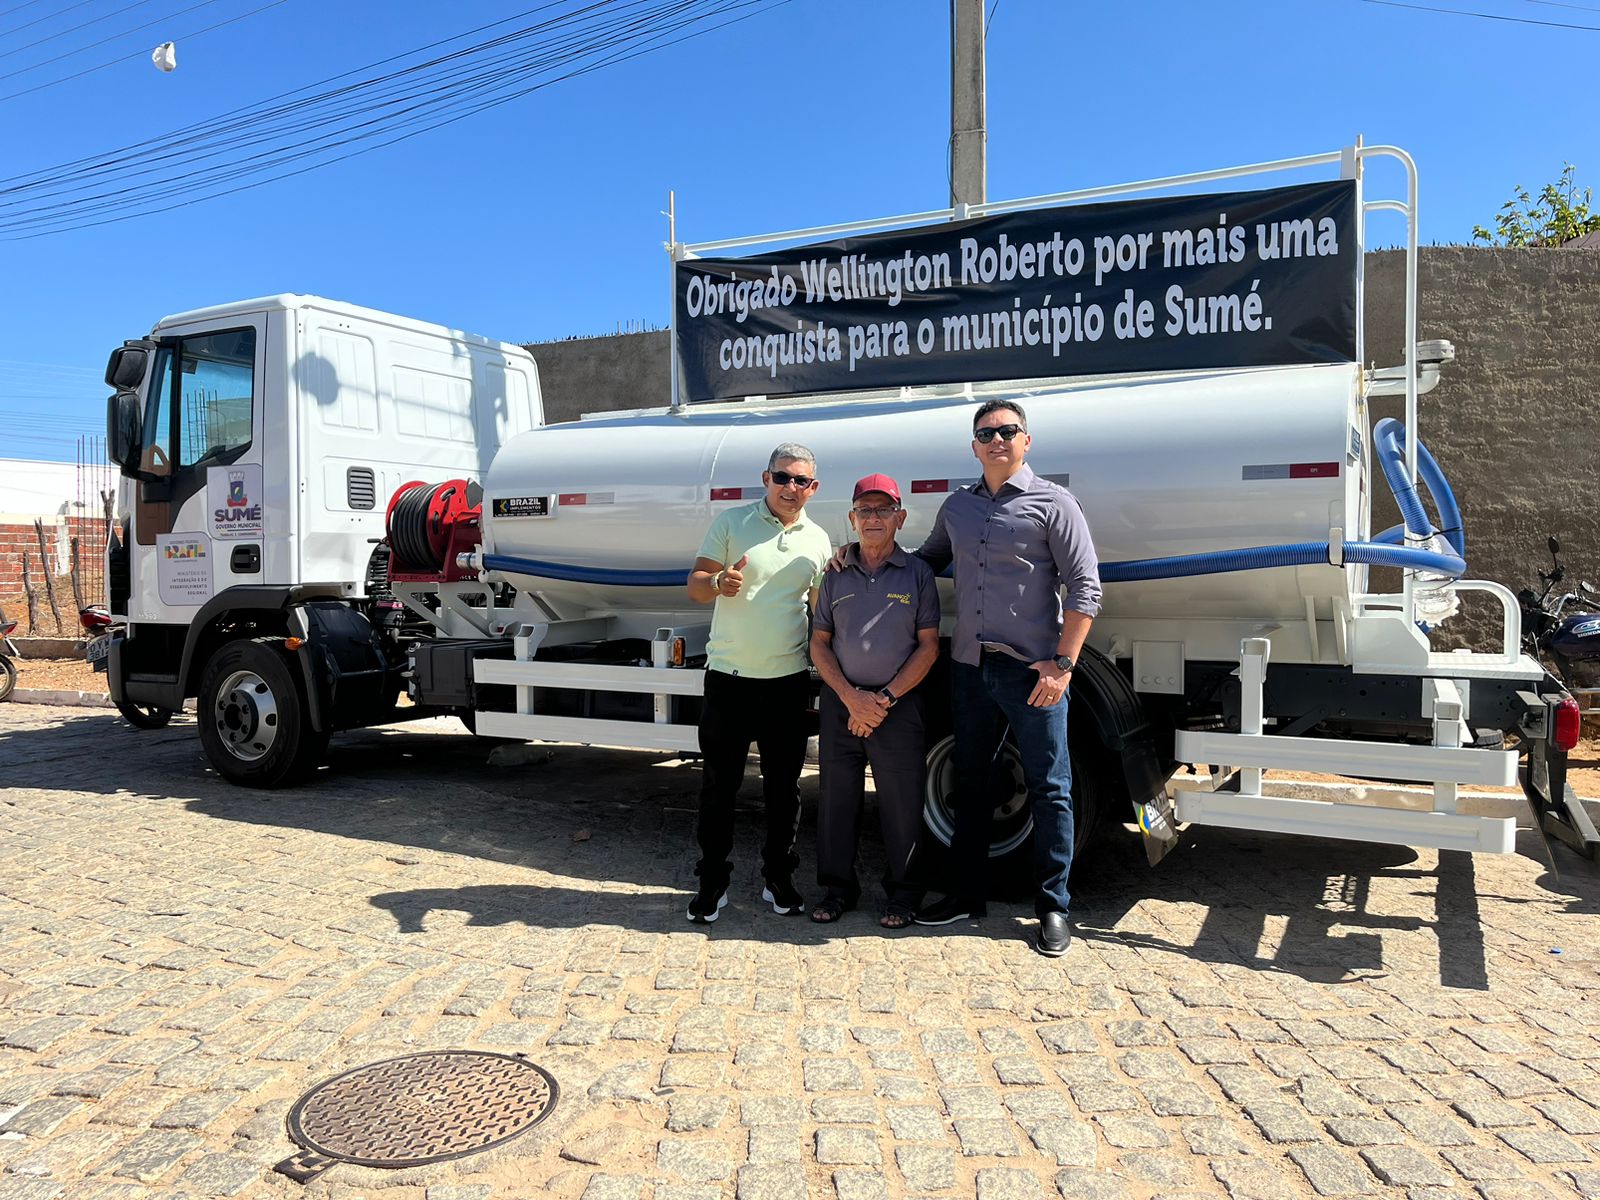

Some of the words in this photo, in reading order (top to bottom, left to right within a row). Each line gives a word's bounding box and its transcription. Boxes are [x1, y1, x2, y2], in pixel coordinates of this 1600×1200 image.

[686, 265, 797, 323] Obrigado
[800, 250, 952, 307] Wellington
[960, 231, 1085, 285] Roberto
[1094, 232, 1153, 286] por
[1162, 213, 1246, 268] mais
[1256, 217, 1338, 261] uma
[719, 320, 842, 377] conquista
[848, 320, 910, 371] para
[917, 318, 935, 354] o
[943, 292, 1105, 357] município
[1113, 288, 1155, 340] de
[1164, 279, 1272, 336] Sumé.
[214, 504, 262, 522] SUMÉ
[510, 498, 541, 506] BRAZIL
